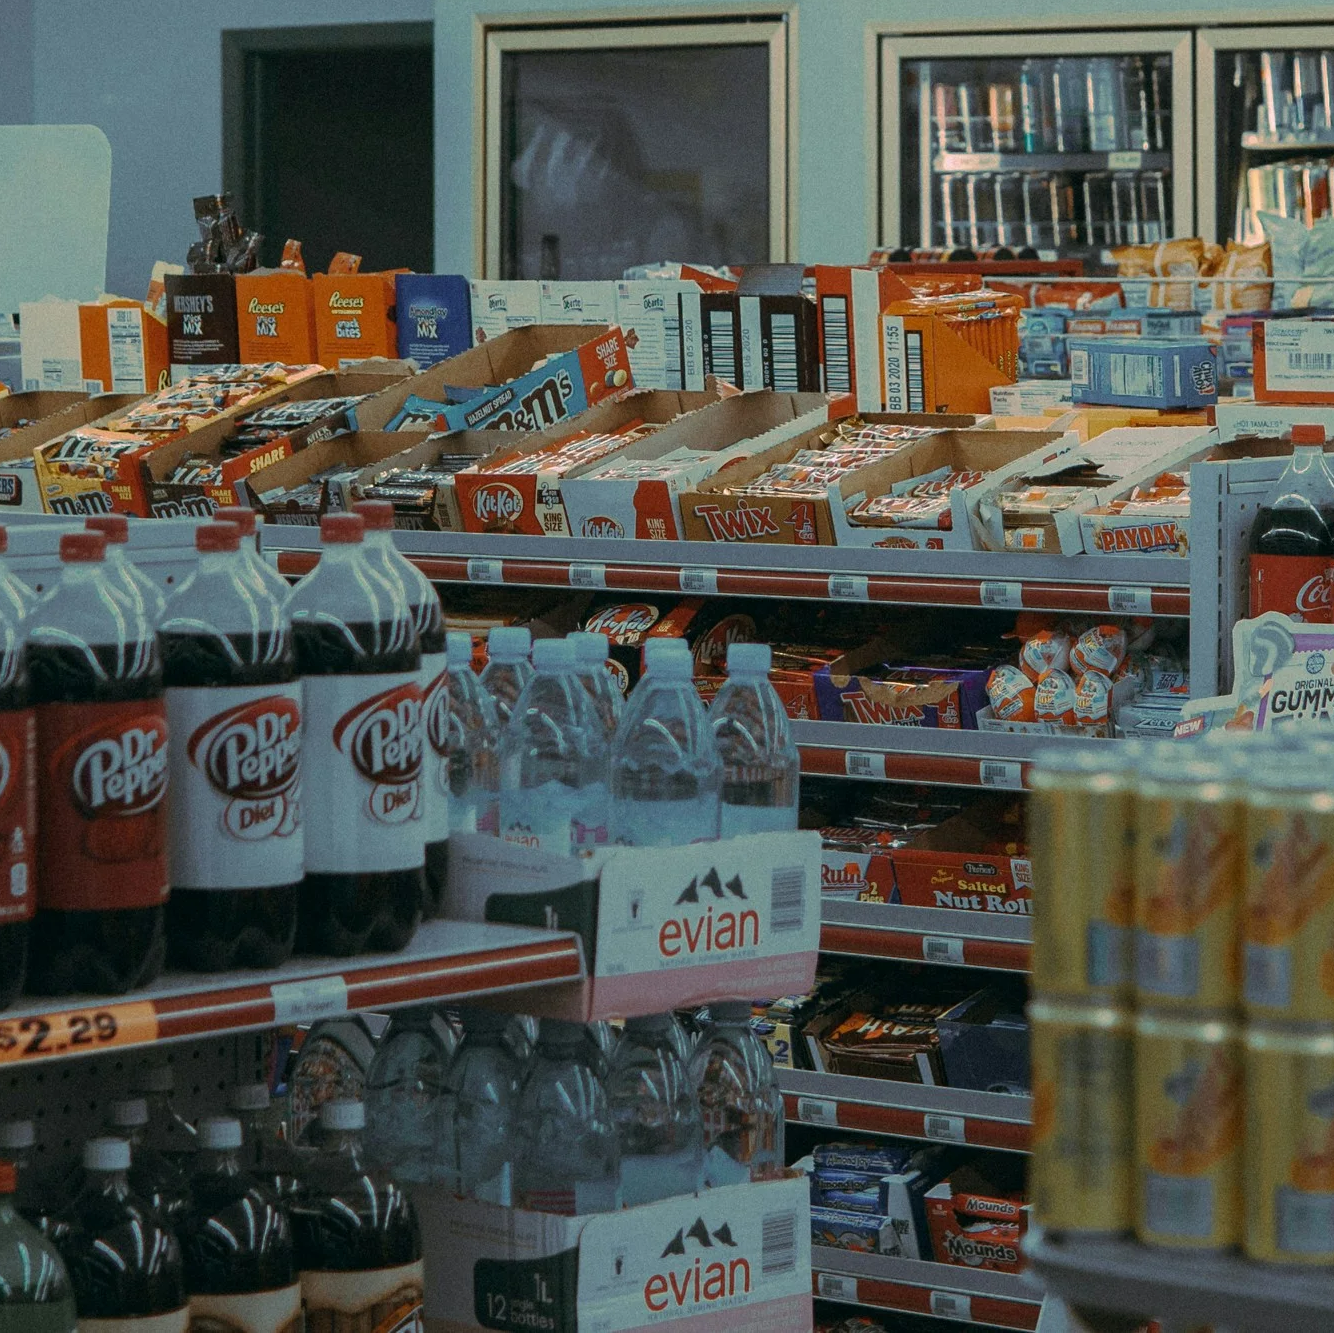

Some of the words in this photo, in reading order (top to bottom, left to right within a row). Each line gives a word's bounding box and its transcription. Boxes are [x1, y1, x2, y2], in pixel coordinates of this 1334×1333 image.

[173, 294, 214, 314] HERSHEY'S
[247, 297, 285, 315] Reese's
[328, 290, 365, 309] Reese's
[182, 321, 204, 336] MIX
[256, 322, 278, 337] MIX
[335, 325, 362, 339] bites
[685, 319, 694, 342] 2020
[742, 328, 751, 352] 2020
[886, 326, 899, 351] 11:55
[596, 336, 620, 361] SHARE
[603, 353, 619, 369] SIZE
[687, 359, 696, 376] BB
[887, 357, 900, 379] 2020
[744, 370, 753, 386] BB
[888, 382, 901, 393] 03
[467, 403, 495, 428] HAZELNUT
[492, 389, 515, 413] SPREAD
[889, 396, 902, 411] BB
[250, 446, 285, 474] SHARE
[111, 484, 132, 494] SHARE
[118, 491, 133, 501] SIZE
[540, 481, 549, 497] 2
[543, 513, 563, 524] KING
[544, 522, 563, 533] SIZE
[645, 518, 666, 530] KING
[649, 527, 668, 540] SIZE
[1101, 522, 1179, 553] PAYDAY
[1294, 677, 1334, 691] ORIGINAL
[257, 712, 292, 743] Dr
[1174, 719, 1203, 738] NEW
[121, 729, 158, 758] Dr
[382, 783, 412, 815] Diet
[239, 799, 279, 830] Diet
[1013, 862, 1031, 874] KING
[957, 879, 1007, 895] Salted
[1015, 872, 1032, 884] SIZE
[870, 882, 878, 896] 2
[933, 890, 981, 910] Nut
[986, 894, 1033, 915] Roll
[658, 905, 760, 958] evian
[774, 1038, 790, 1058] 2
[827, 1154, 853, 1166] Almond
[966, 1197, 1015, 1215] Mounds
[947, 1235, 1017, 1262] Mounds
[643, 1256, 750, 1313] evian
[486, 1292, 508, 1322] 12
[648, 1307, 685, 1322] NATURAL
[722, 1294, 749, 1308] WATER
